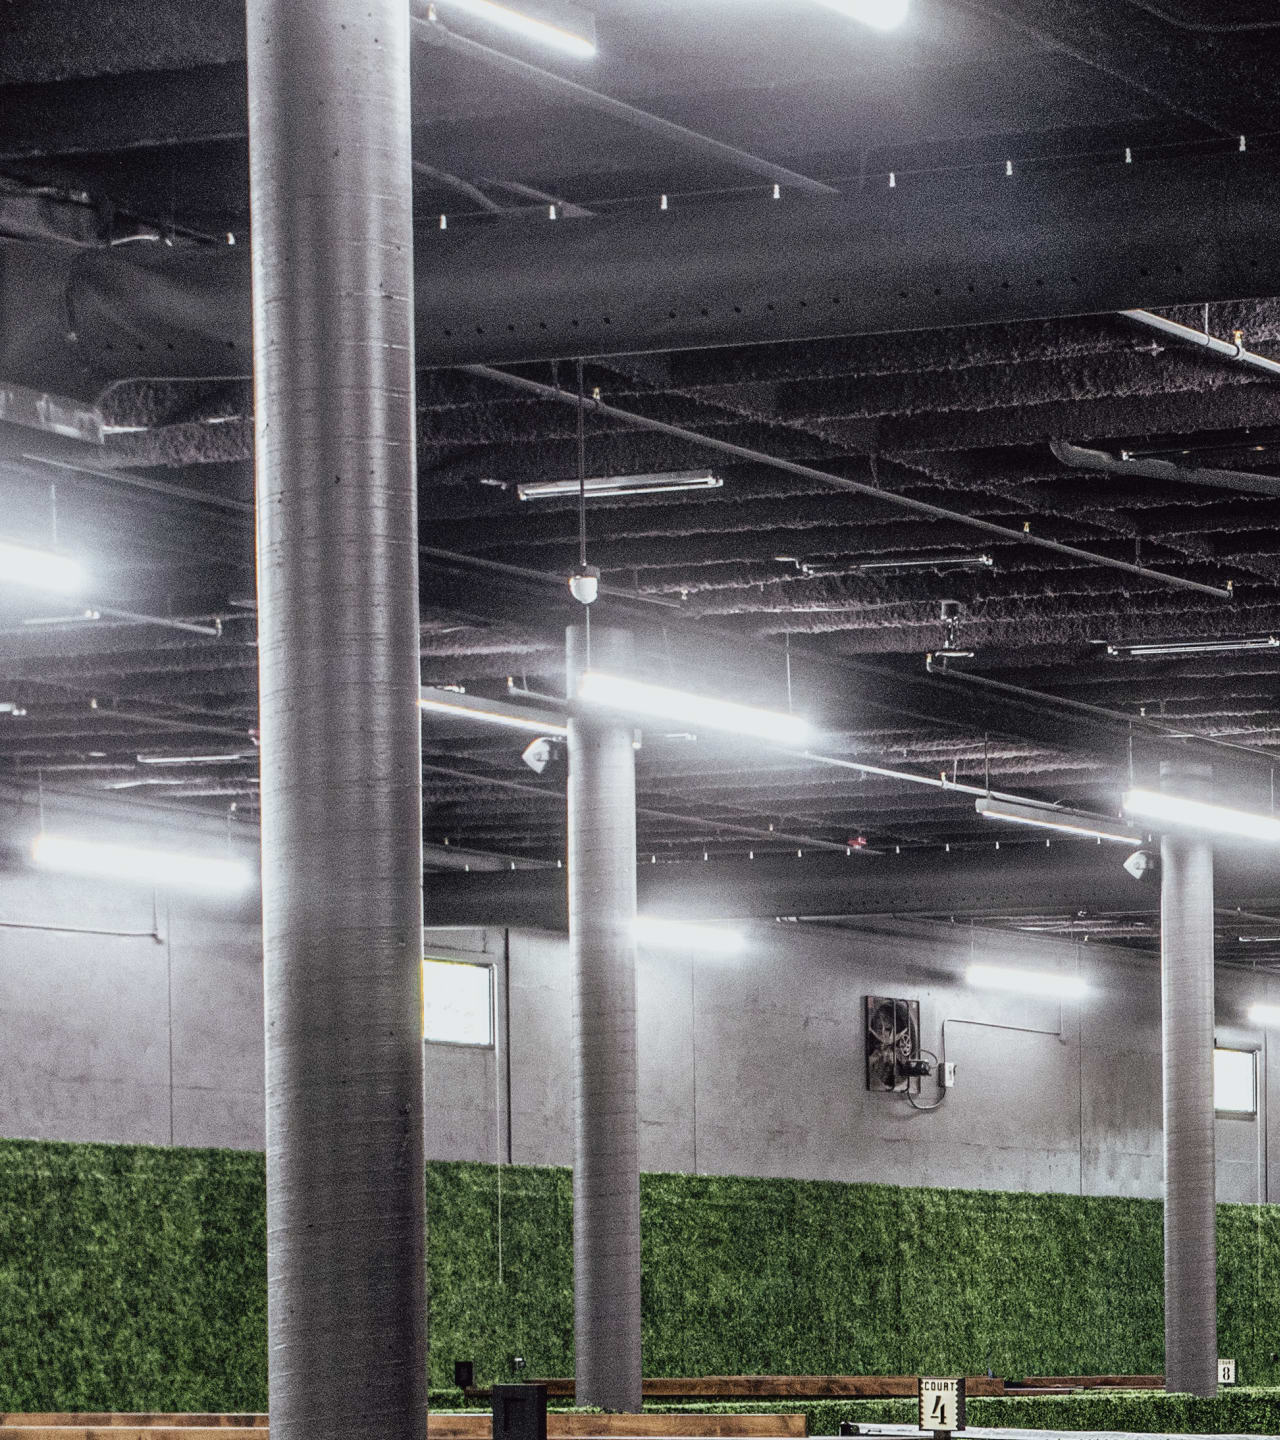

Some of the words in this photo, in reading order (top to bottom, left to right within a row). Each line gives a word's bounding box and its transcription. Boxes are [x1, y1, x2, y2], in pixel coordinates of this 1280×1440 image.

[1222, 1366, 1230, 1381] 8
[924, 1381, 955, 1391] COURT
[930, 1395, 947, 1425] 4
